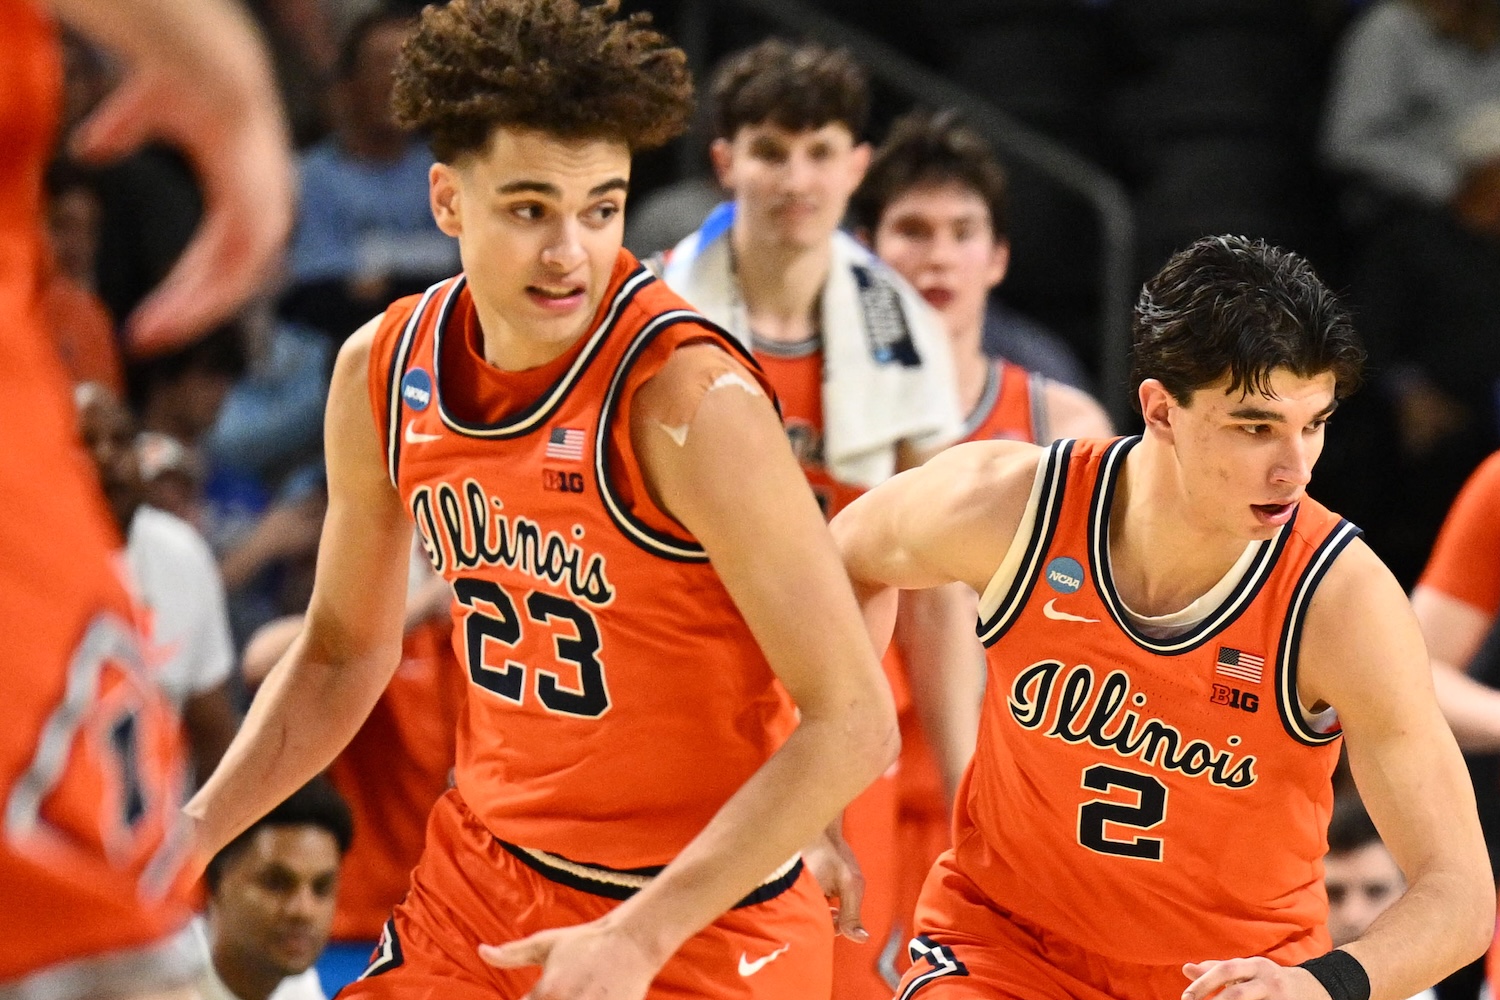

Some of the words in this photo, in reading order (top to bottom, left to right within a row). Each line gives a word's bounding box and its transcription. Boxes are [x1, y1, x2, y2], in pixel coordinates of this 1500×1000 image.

[410, 478, 616, 605] Illinois
[1048, 570, 1080, 590] NCAA
[453, 576, 613, 720] 23
[1007, 658, 1259, 789] Illinois
[1076, 762, 1170, 863] 2
